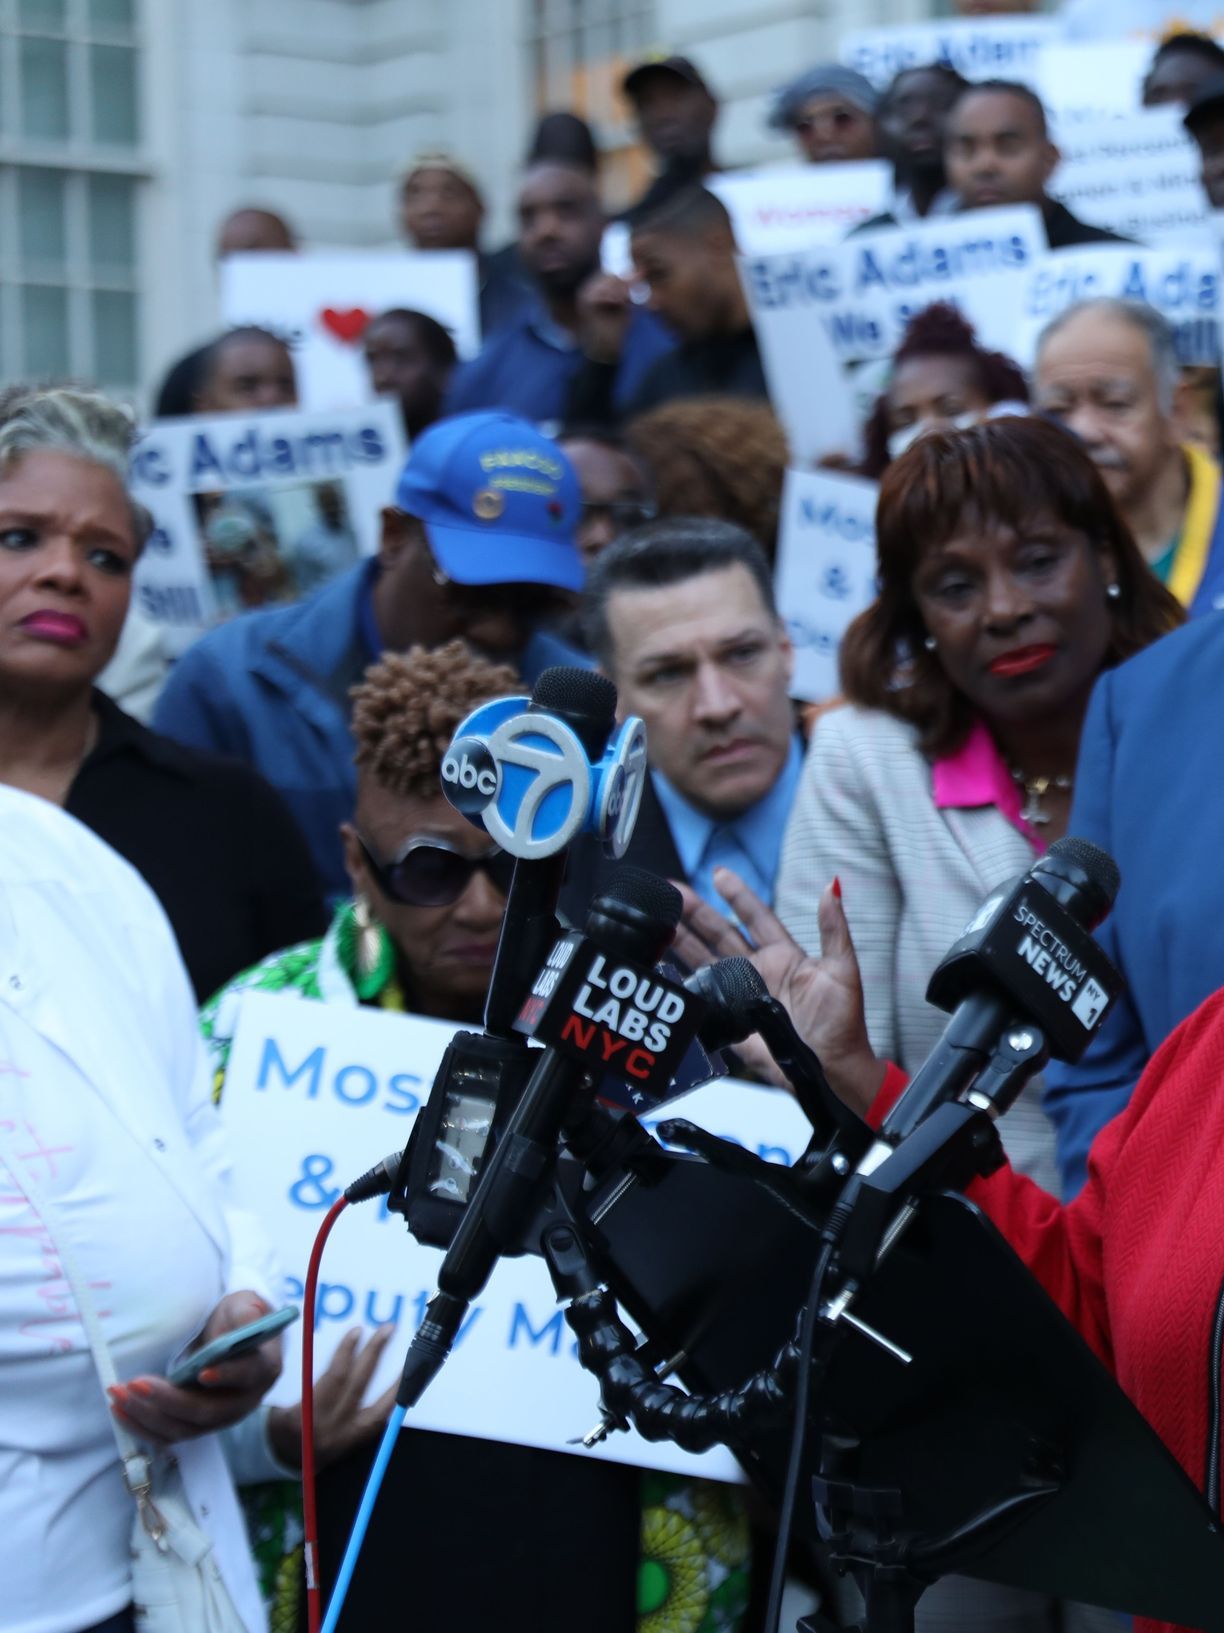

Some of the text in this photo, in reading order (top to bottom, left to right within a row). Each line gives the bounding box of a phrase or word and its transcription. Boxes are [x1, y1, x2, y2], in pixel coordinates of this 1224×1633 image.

[752, 234, 1030, 309] Eric Adams
[1124, 260, 1218, 308] Ada
[192, 426, 388, 479] Adams
[441, 728, 580, 853] abc 7
[1013, 906, 1088, 984] SPECTRUM
[1016, 936, 1078, 1003] NEWS
[572, 984, 672, 1053] LABS
[587, 954, 686, 1025] LOUD
[1086, 985, 1101, 999] NY
[1088, 1007, 1099, 1024] 1
[254, 1036, 428, 1117] Mos
[560, 1014, 657, 1080] NYC
[289, 1152, 343, 1212] &
